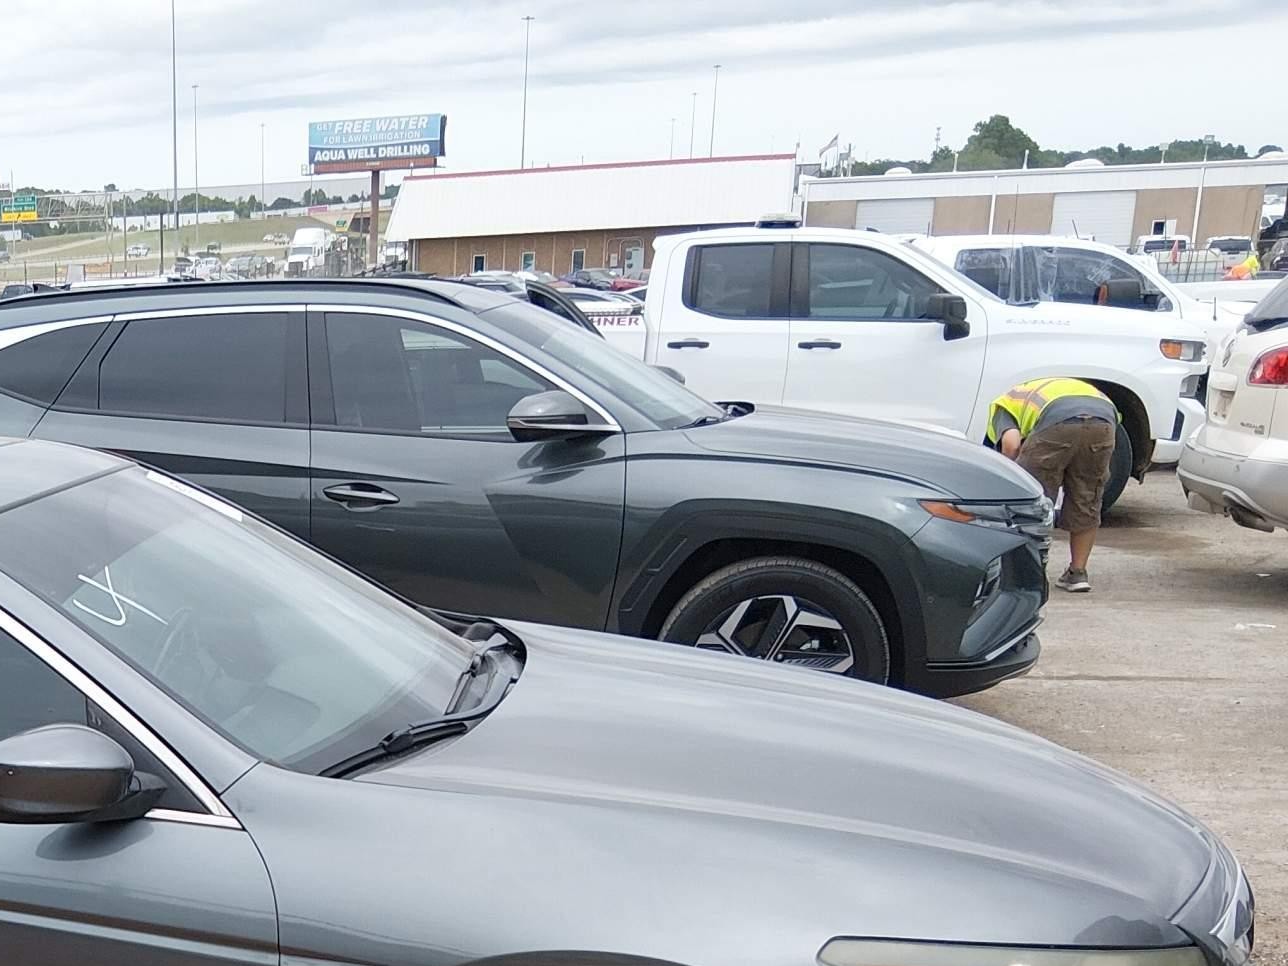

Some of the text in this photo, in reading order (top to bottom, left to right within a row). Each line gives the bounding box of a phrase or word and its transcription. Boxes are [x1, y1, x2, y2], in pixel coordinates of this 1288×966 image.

[316, 115, 430, 134] GET FREE WATER
[323, 131, 421, 145] FOR LAWN IRRIGATION
[314, 143, 431, 162] AQUA WELL DRILLING
